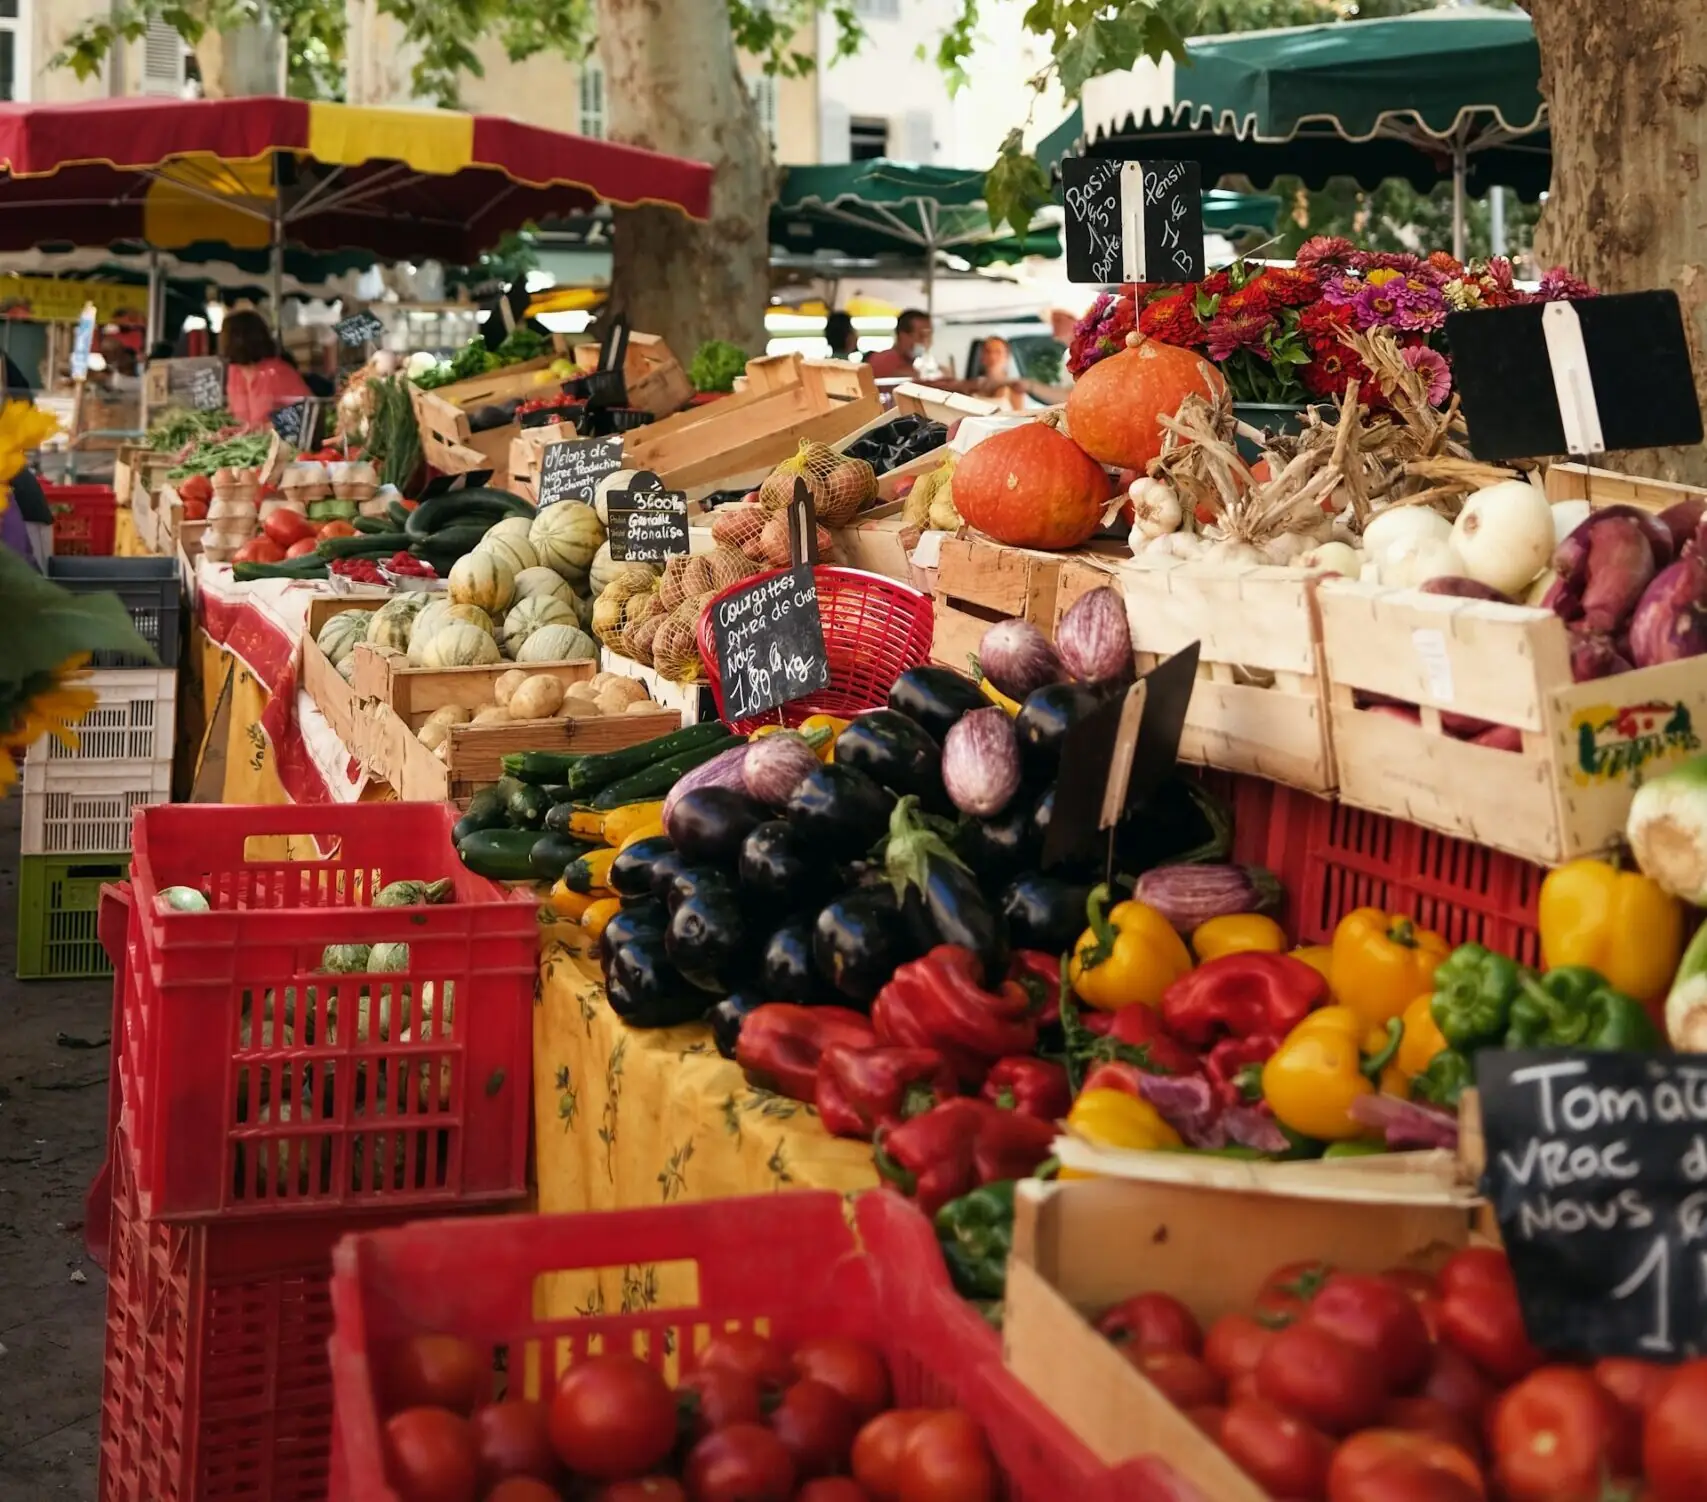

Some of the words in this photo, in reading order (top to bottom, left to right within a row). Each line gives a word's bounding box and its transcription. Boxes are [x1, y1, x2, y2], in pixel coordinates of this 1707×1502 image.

[1172, 249, 1193, 275] B
[545, 443, 586, 471] Melons
[590, 444, 610, 458] de
[627, 525, 685, 542] Monalisa
[719, 575, 795, 627] Courgettes
[771, 601, 790, 621] de
